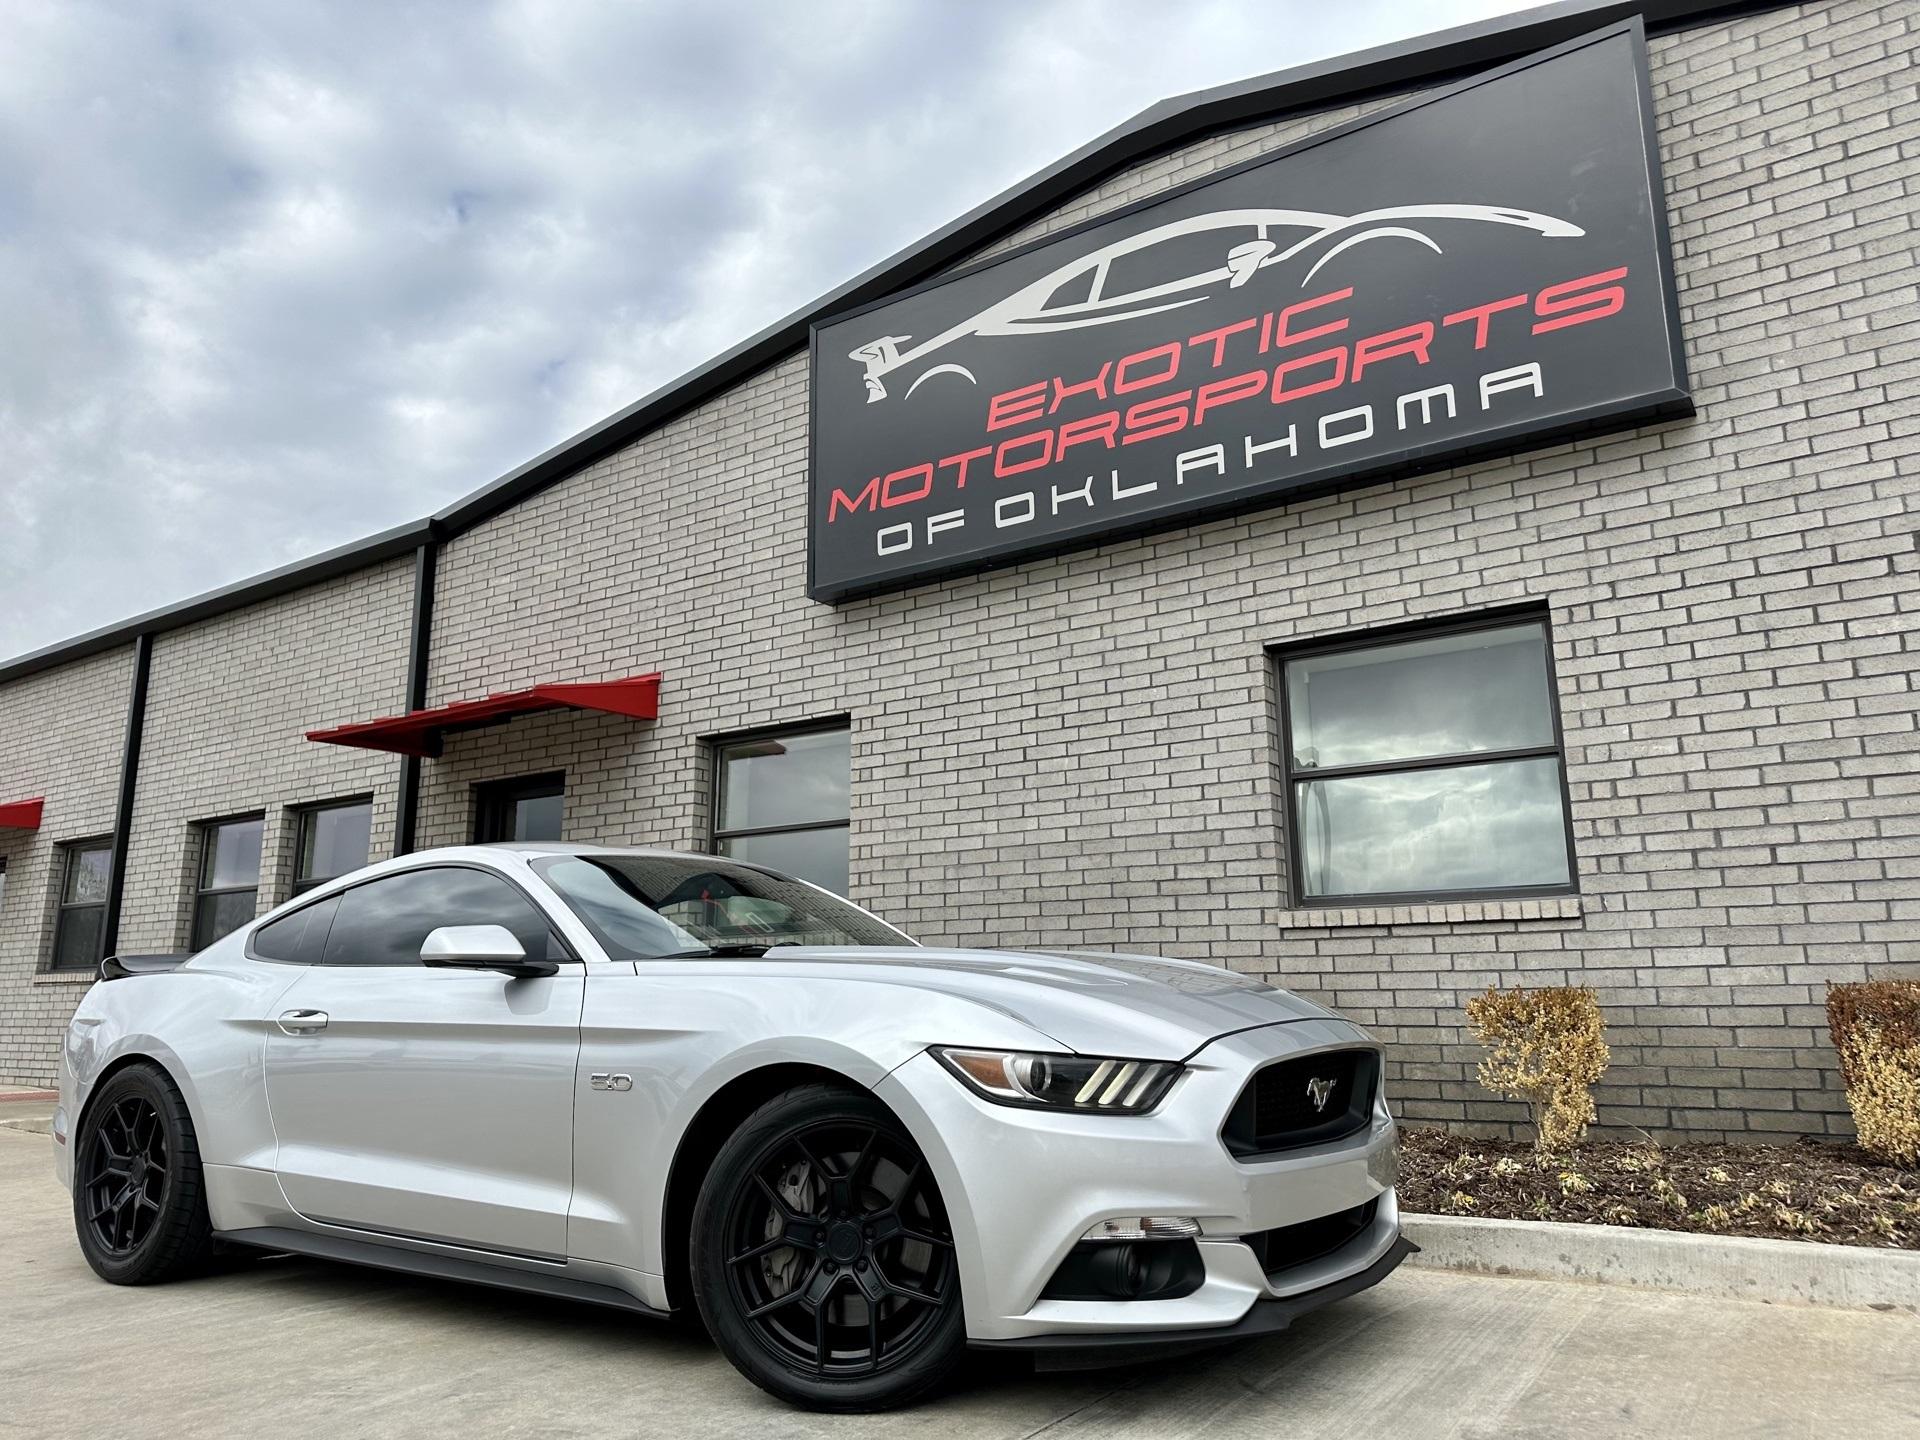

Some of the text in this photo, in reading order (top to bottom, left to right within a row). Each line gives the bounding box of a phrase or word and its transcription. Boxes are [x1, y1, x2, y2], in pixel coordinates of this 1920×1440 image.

[828, 266, 1628, 522] MOTORSPORTS
[987, 288, 1353, 432] EXOTIC
[876, 361, 1544, 557] OF OKLAHOMA
[590, 1072, 633, 1091] 5.0
